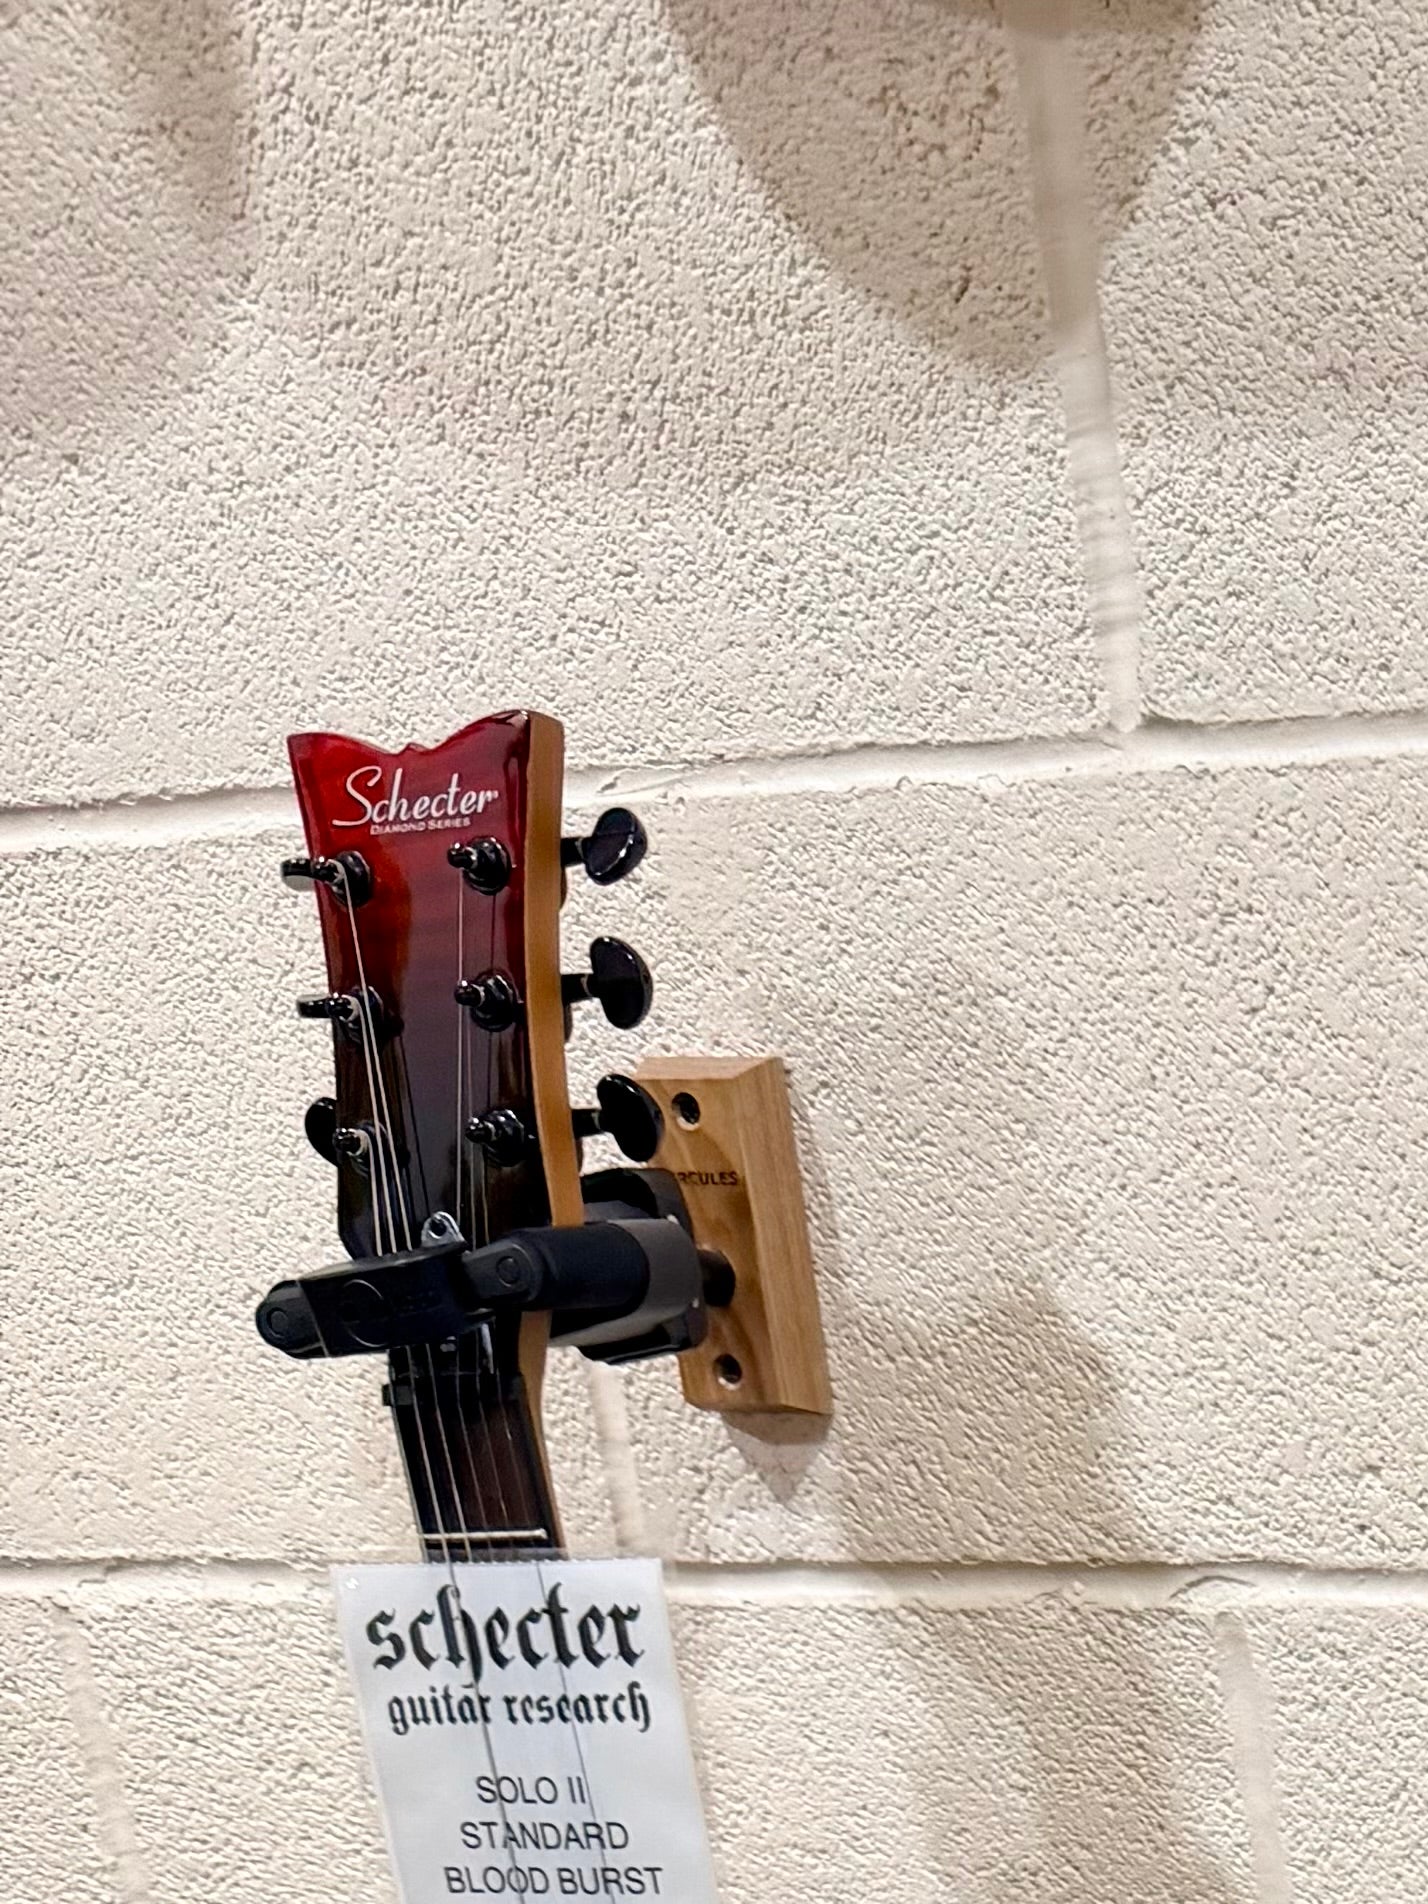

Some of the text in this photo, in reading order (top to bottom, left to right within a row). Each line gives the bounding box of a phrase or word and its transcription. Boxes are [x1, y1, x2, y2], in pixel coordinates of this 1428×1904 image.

[332, 766, 498, 826] Schecter
[370, 817, 470, 835] DIAMOND SERIES
[677, 1170, 738, 1186] RCULES
[365, 1582, 646, 1683] schecter
[388, 1681, 652, 1736] guitar research
[476, 1776, 587, 1805] SOLO II
[460, 1822, 630, 1851] STANDARD
[444, 1867, 663, 1896] BLOOD BURST
